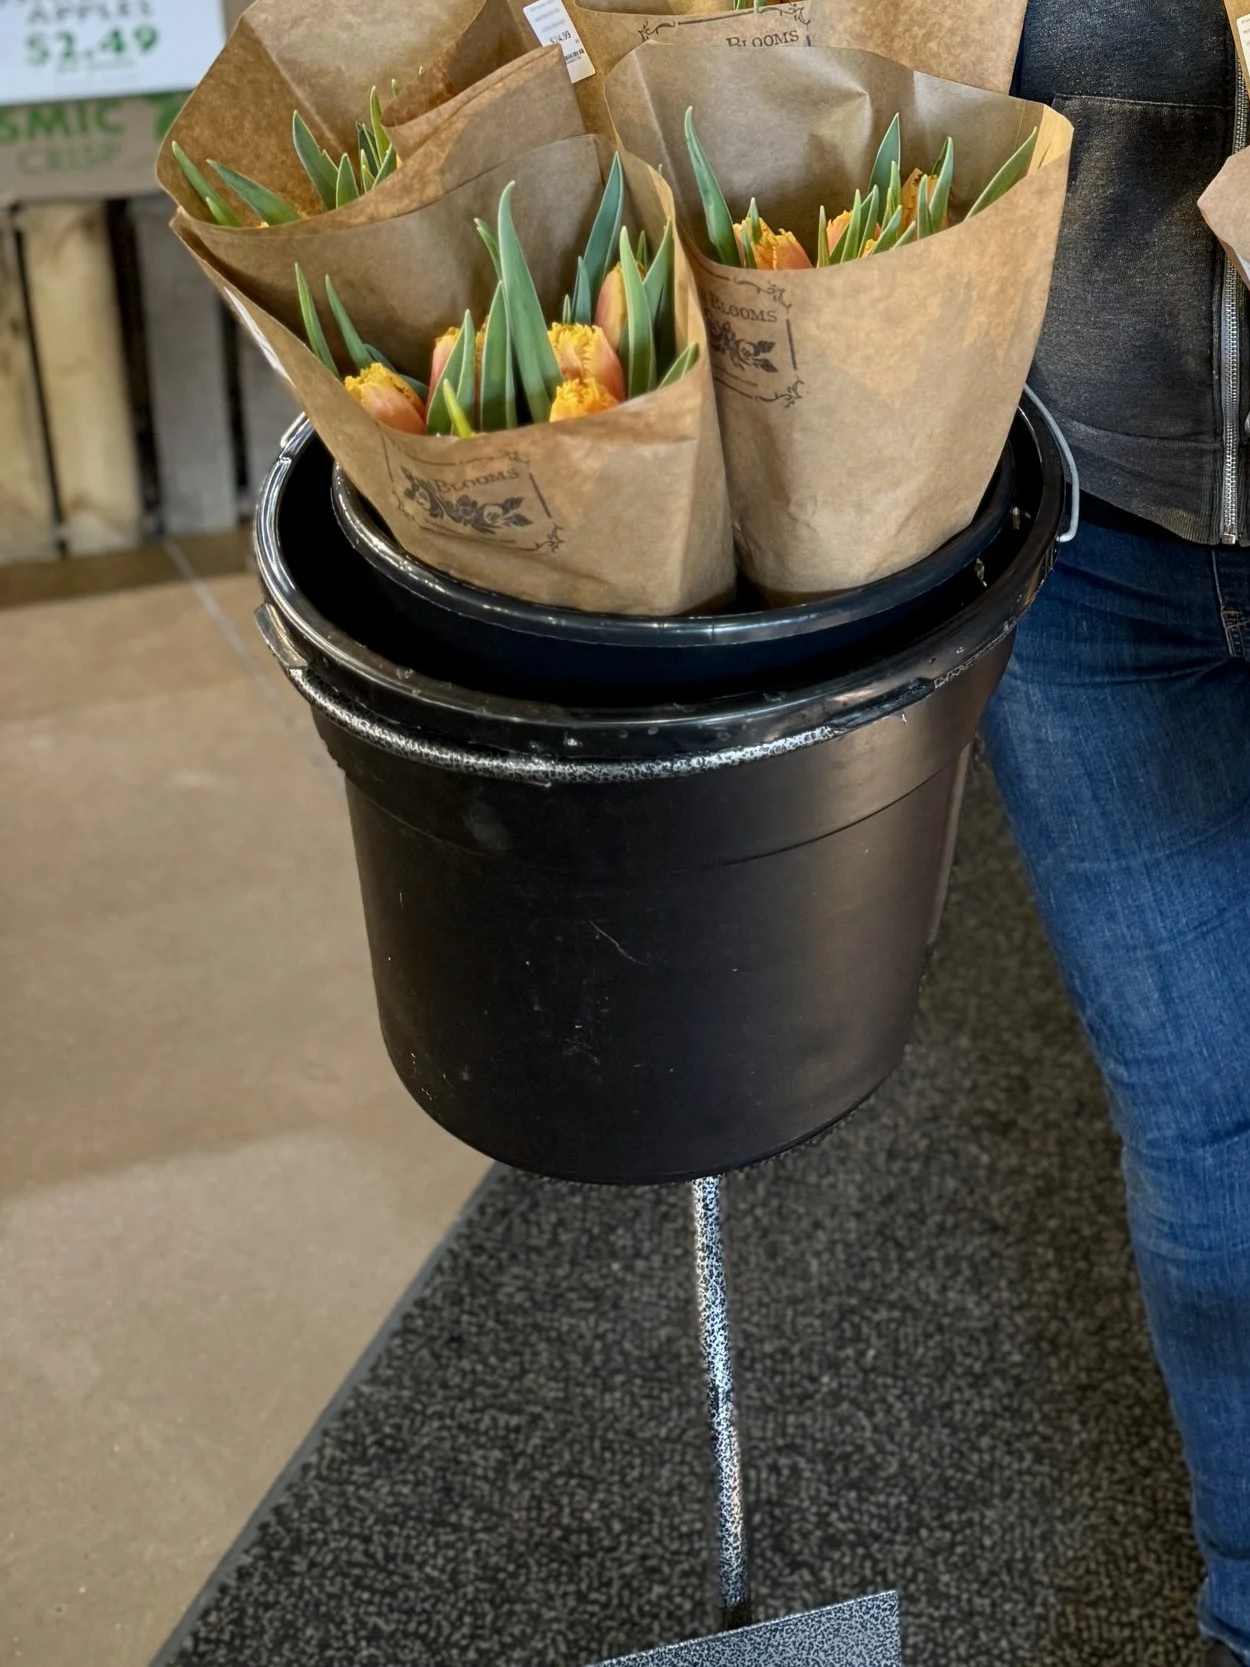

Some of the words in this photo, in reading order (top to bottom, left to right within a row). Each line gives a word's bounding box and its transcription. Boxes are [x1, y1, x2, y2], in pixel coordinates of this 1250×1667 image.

[24, 24, 159, 66] $2.49
[708, 290, 778, 323] BLOOMS
[436, 467, 520, 494] BLOOMS
